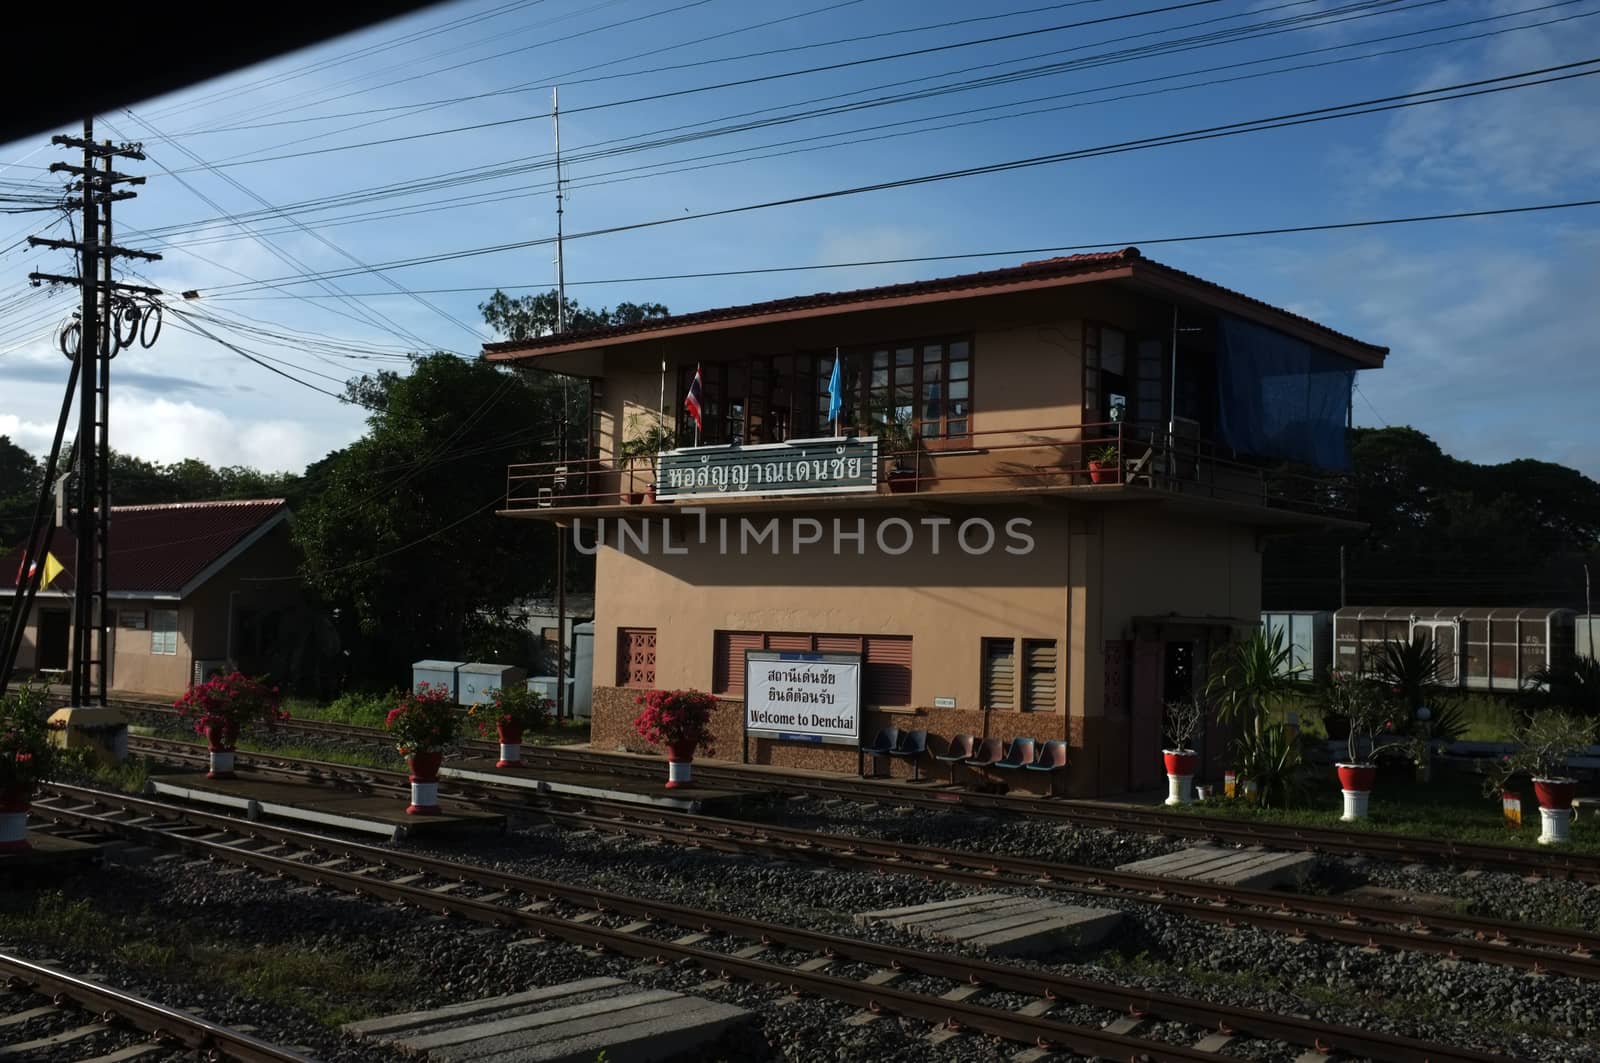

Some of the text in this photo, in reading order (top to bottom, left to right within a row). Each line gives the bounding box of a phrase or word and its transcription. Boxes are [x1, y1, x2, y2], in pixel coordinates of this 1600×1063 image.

[668, 444, 861, 491] หอสัญญาณเด่นชัย
[768, 668, 836, 685] สถานีเด่นชัย
[768, 687, 835, 704] ยินดีต้อนรับ
[751, 710, 853, 729] Welcome to Denchai
